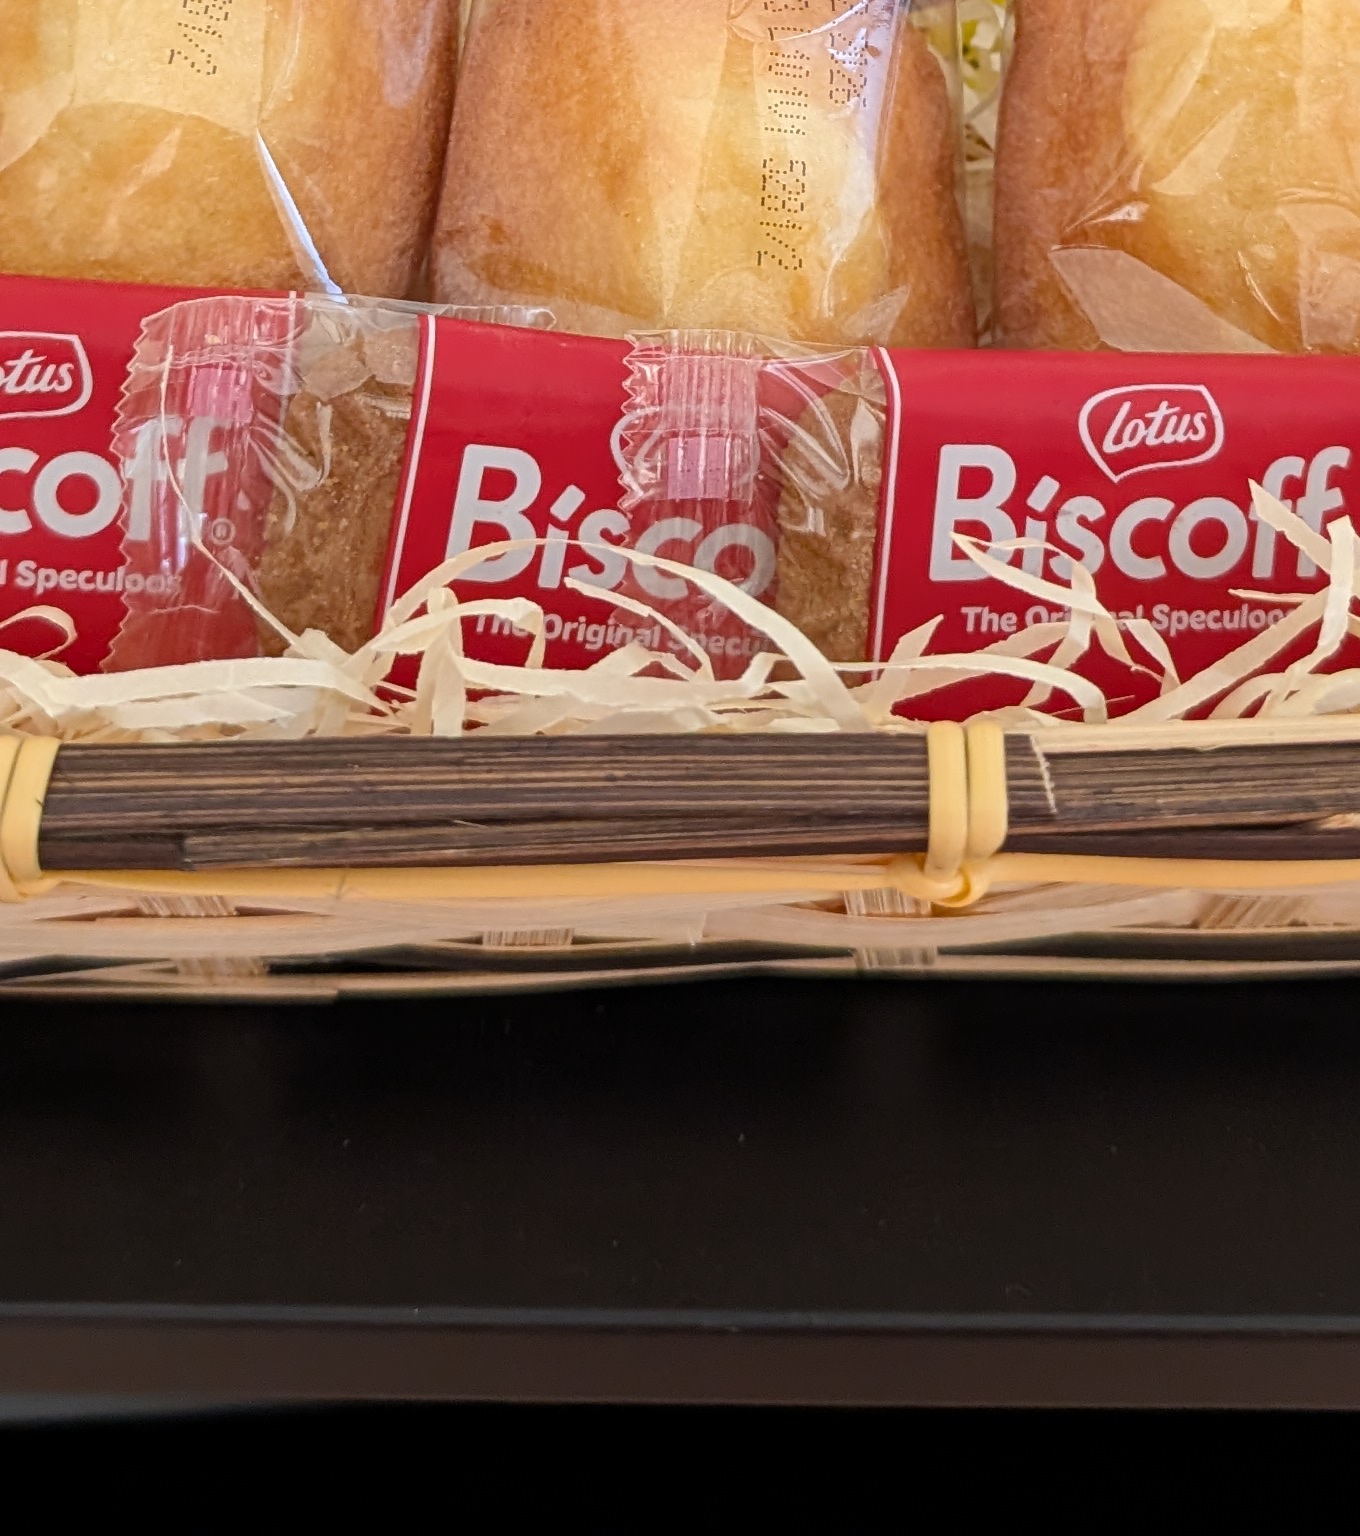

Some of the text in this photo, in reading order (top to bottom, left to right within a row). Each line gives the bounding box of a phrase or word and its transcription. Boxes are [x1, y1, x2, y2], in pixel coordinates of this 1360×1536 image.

[442, 443, 778, 602] Bisco
[928, 443, 1351, 581] Biscoff
[14, 558, 181, 596] Speculoos
[543, 616, 660, 650] Original
[669, 626, 773, 656] Specu
[961, 606, 1016, 633] The
[1152, 603, 1295, 637] Speculoo
